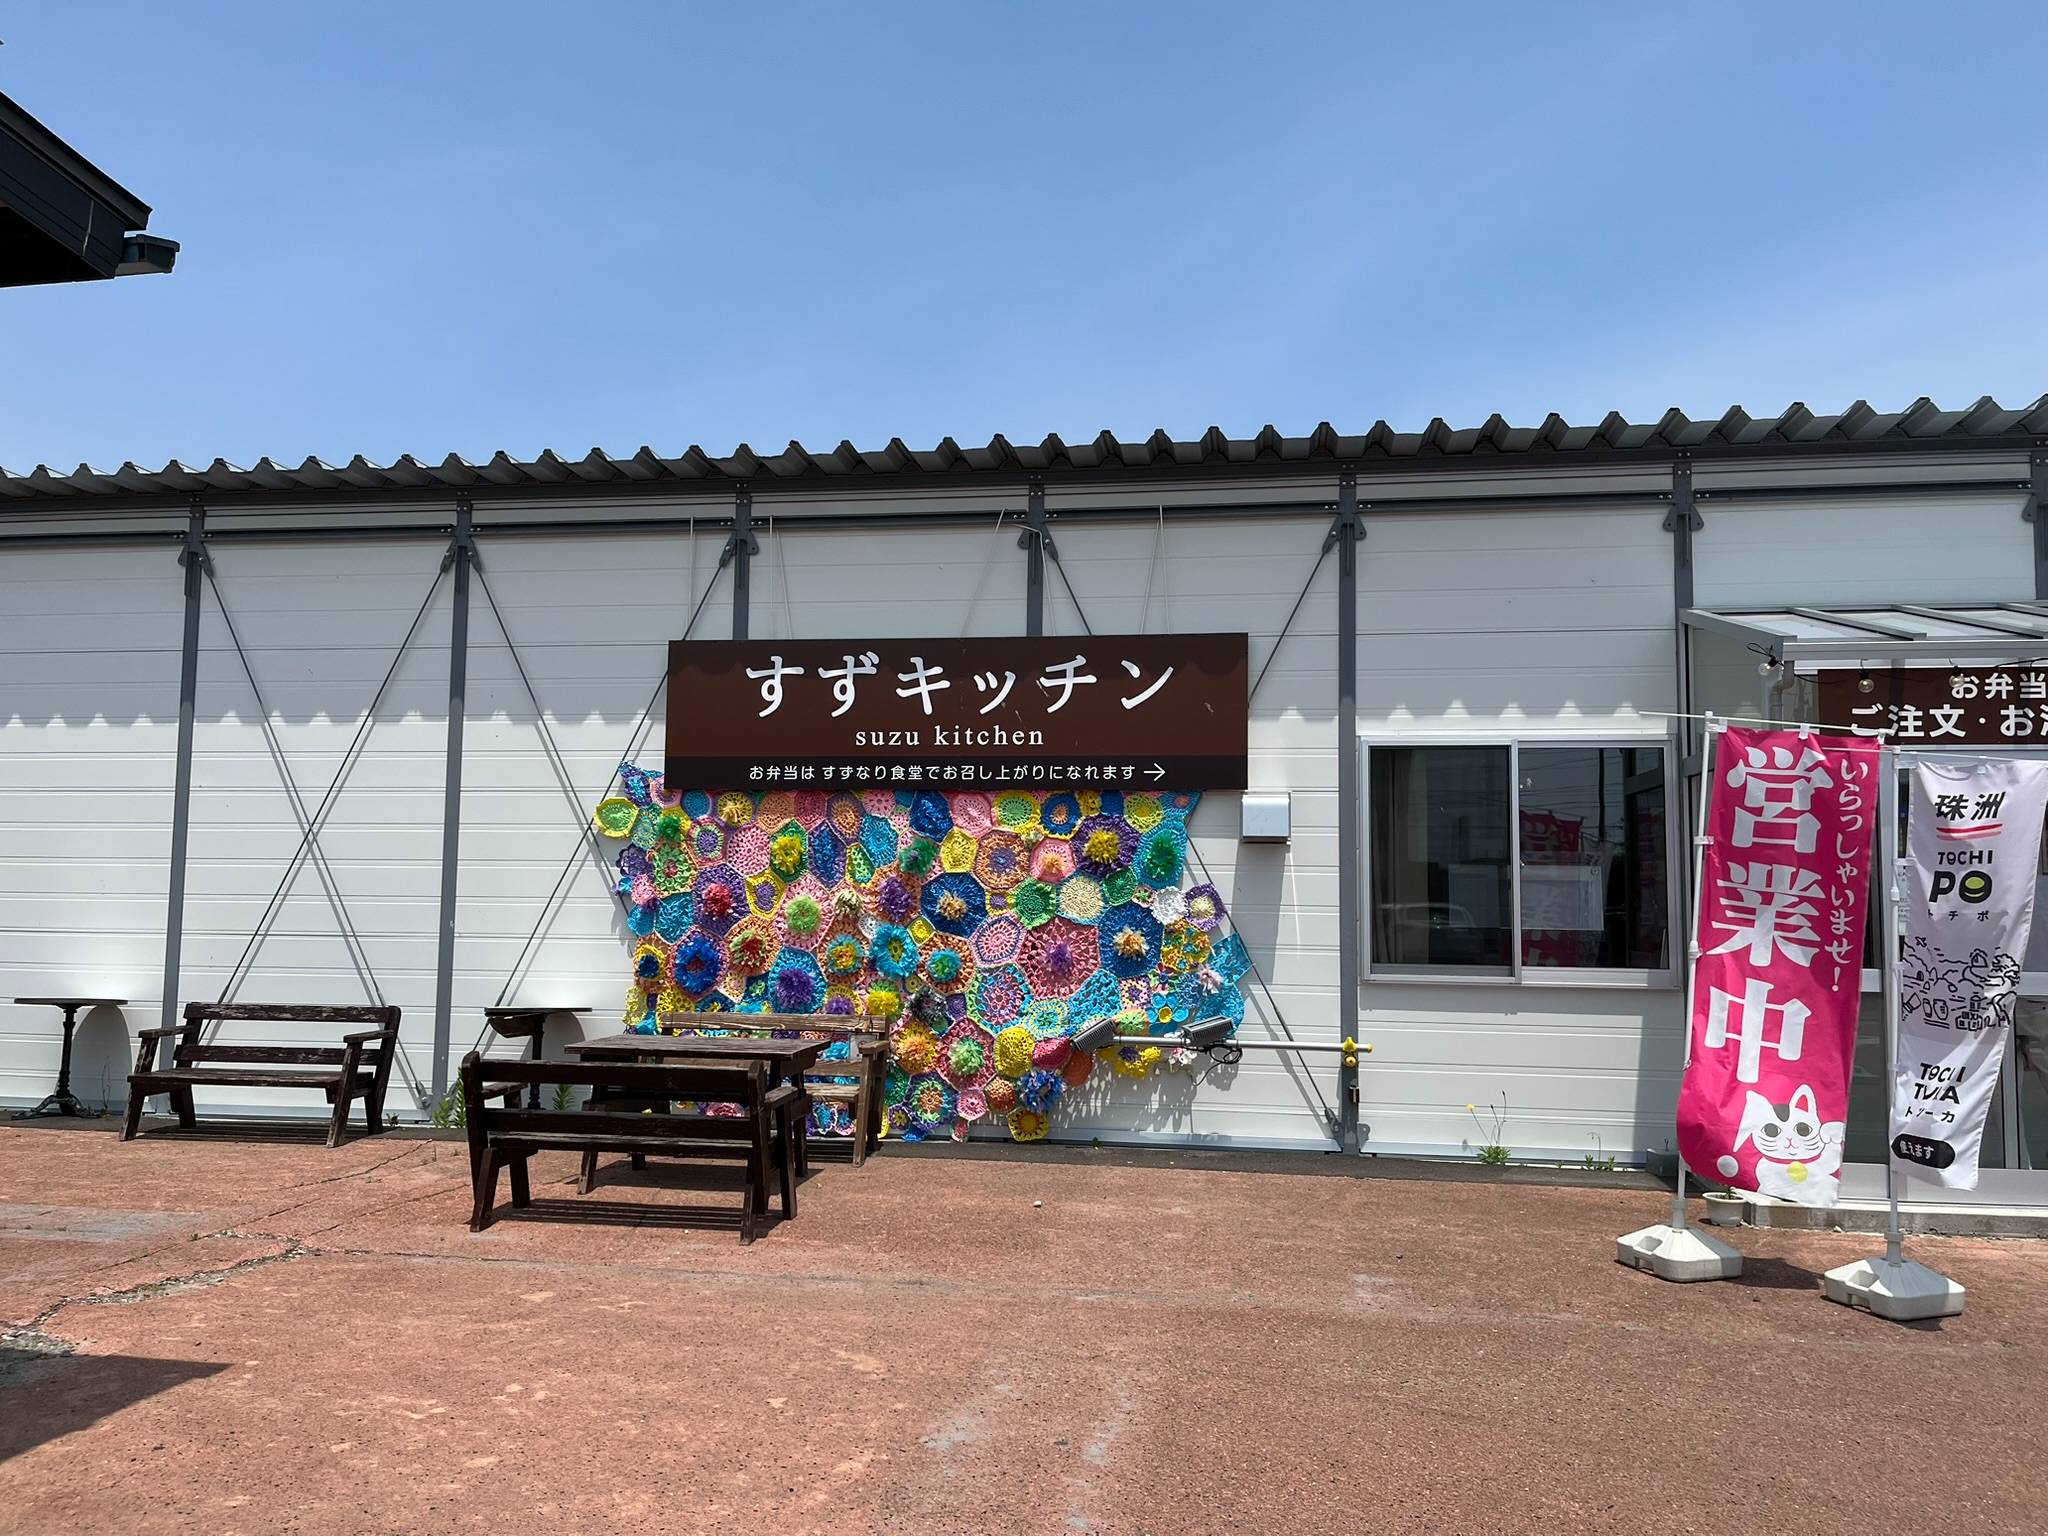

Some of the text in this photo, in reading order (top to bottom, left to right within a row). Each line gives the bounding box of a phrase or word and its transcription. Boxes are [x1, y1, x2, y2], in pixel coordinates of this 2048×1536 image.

[746, 651, 1174, 719] すずキッチン
[1951, 672, 2046, 699] お弁当
[855, 724, 1045, 746] suzu kitchen
[749, 765, 815, 780] お弁当は
[1934, 791, 2006, 821] 珠洲
[1938, 850, 1993, 865] TOCHI
[1929, 870, 1993, 904] PO
[1704, 746, 1833, 1083] 営業中
[1920, 1063, 1966, 1082] TOCI
